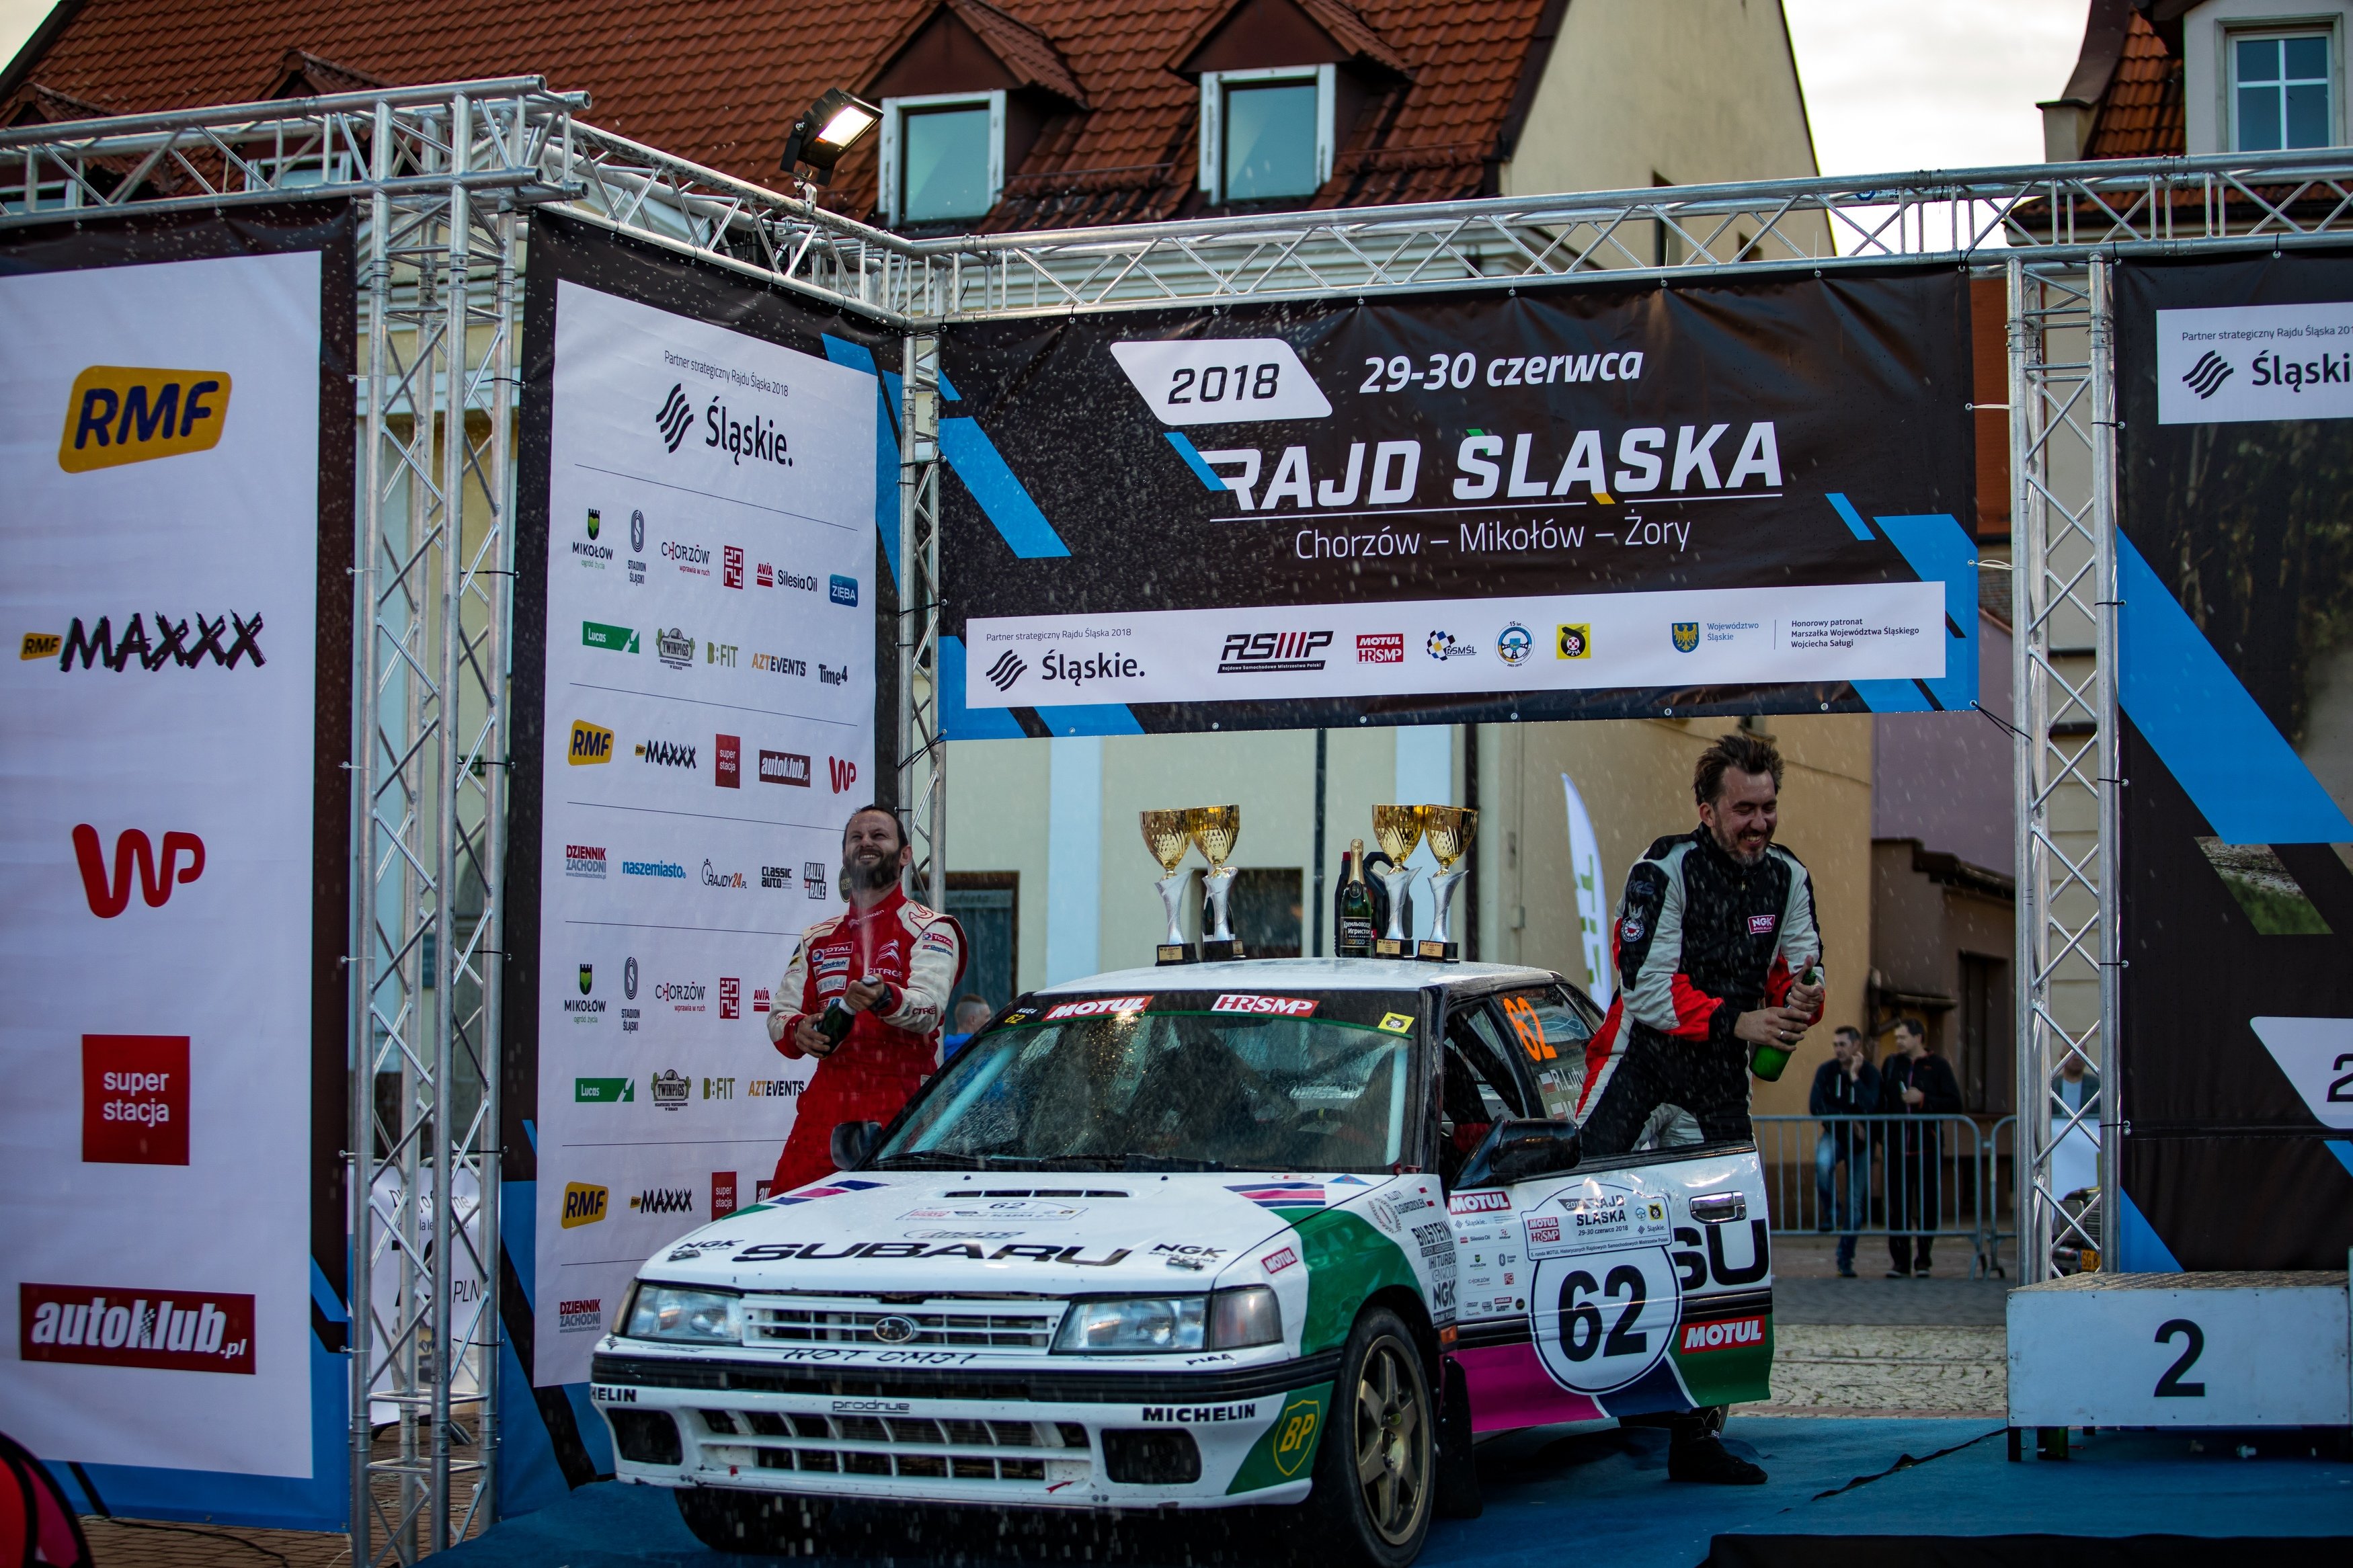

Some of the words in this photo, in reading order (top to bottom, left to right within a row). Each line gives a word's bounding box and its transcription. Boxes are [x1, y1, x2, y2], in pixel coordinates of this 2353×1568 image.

[2182, 331, 2217, 341] Partner
[2219, 329, 2274, 341] strategiczny
[2277, 327, 2303, 339] Rajdu
[2305, 324, 2336, 337] Śląska
[2338, 326, 2353, 335] 201
[664, 350, 690, 368] Partner
[690, 360, 731, 384] strategiczny
[731, 369, 750, 386] Rajdu
[750, 372, 771, 392] Śląska
[772, 381, 789, 397] 2018
[1359, 351, 1476, 395] 29-30
[1486, 349, 1644, 388] czerwca
[2251, 349, 2353, 393] Śląski
[1167, 362, 1279, 405] 2018
[74, 380, 220, 450] RMF
[705, 395, 793, 467] Śląskie.
[1197, 439, 1422, 511] RAJD
[1295, 525, 1421, 561] Chorzów
[1459, 518, 1585, 553] Mikołów
[1624, 508, 1691, 553] Żory
[572, 542, 613, 561] MIKOŁÓW
[661, 541, 711, 565] CHORZÓW
[628, 560, 647, 572] STADION
[679, 565, 696, 574] wprawia
[629, 571, 645, 586] ŚLĄSKI
[777, 569, 805, 590] Silesia
[806, 575, 817, 592] Oil
[832, 585, 856, 600] ZIĘBA
[1706, 621, 1759, 631] Województwo
[1791, 619, 1829, 628] Honorowy
[1830, 618, 1863, 627] patronat
[24, 637, 60, 655] RMF
[60, 609, 267, 672] MAXXX
[588, 628, 606, 643] Lucas
[986, 633, 1014, 641] Partner
[1015, 632, 1060, 641] strategiczny
[1062, 630, 1083, 639] Rajdu
[1084, 628, 1109, 639] Śląska
[1111, 628, 1131, 636] 2018
[1706, 632, 1734, 642] Śląskie
[1791, 628, 1829, 637] Marszałka
[1830, 627, 1882, 638] Województwa
[1883, 626, 1919, 636] Śląskiego
[1359, 636, 1401, 646] MOTUL
[1790, 639, 1828, 649] Wojciecha
[1829, 638, 1853, 649] Saługi
[1358, 649, 1402, 662] HRSMP
[1041, 649, 1146, 686] Śląskie.
[572, 729, 611, 757] RMF
[635, 746, 645, 754] RMF
[645, 739, 696, 769] MAXXX
[719, 749, 735, 759] super
[719, 761, 735, 773] stacja
[829, 755, 856, 794] WP
[566, 845, 606, 861] DZIENNIK
[72, 823, 206, 919] WP
[566, 858, 606, 873] ZACHODNI
[805, 863, 824, 880] RALLY
[809, 882, 826, 899] RACE
[1752, 917, 1773, 927] NGK
[655, 981, 706, 1001] CHORZÓW
[564, 999, 606, 1012] MIKOŁÓW
[621, 1008, 641, 1019] STADION
[674, 1004, 692, 1014] wprawia
[1046, 997, 1146, 1020] MOTUL
[1216, 996, 1313, 1014] HRSMP
[573, 1014, 586, 1024] ogród
[587, 1015, 598, 1024] życia
[623, 1019, 639, 1034] ŚLĄSKI
[1004, 1014, 1026, 1024] 62
[1503, 997, 1558, 1062] 62
[104, 1070, 169, 1097] super
[581, 1083, 600, 1097] Lucas
[657, 1083, 686, 1097] TWINPIGS
[103, 1098, 170, 1128] stacja
[715, 1186, 732, 1196] super
[565, 1190, 606, 1219] RMF
[640, 1188, 692, 1214] MAXXX
[715, 1198, 733, 1208] stacja
[1449, 1193, 1509, 1212] MOTUL
[1528, 1217, 1558, 1229] MOTUL
[1410, 1220, 1452, 1247] BILSTEIN
[1531, 1229, 1560, 1242] HRSMP
[677, 1239, 745, 1249] NGK
[1152, 1243, 1227, 1258] NGK
[731, 1241, 1133, 1267] SUBARU
[1264, 1252, 1295, 1273] MOTUL
[1437, 1251, 1456, 1268] TURBO
[1432, 1265, 1458, 1282] KENWOOD
[453, 1280, 479, 1303] PLN
[1433, 1280, 1456, 1310] NGK
[559, 1299, 601, 1315] DZIENNIK
[1558, 1264, 1648, 1362] 62
[559, 1313, 601, 1327] ZACHODNI
[1684, 1319, 1763, 1349] MOTUL
[2153, 1318, 2206, 1397] 2
[832, 1399, 910, 1412] prodrive
[1142, 1403, 1257, 1423] MICHELIN
[1279, 1415, 1314, 1453] BP
